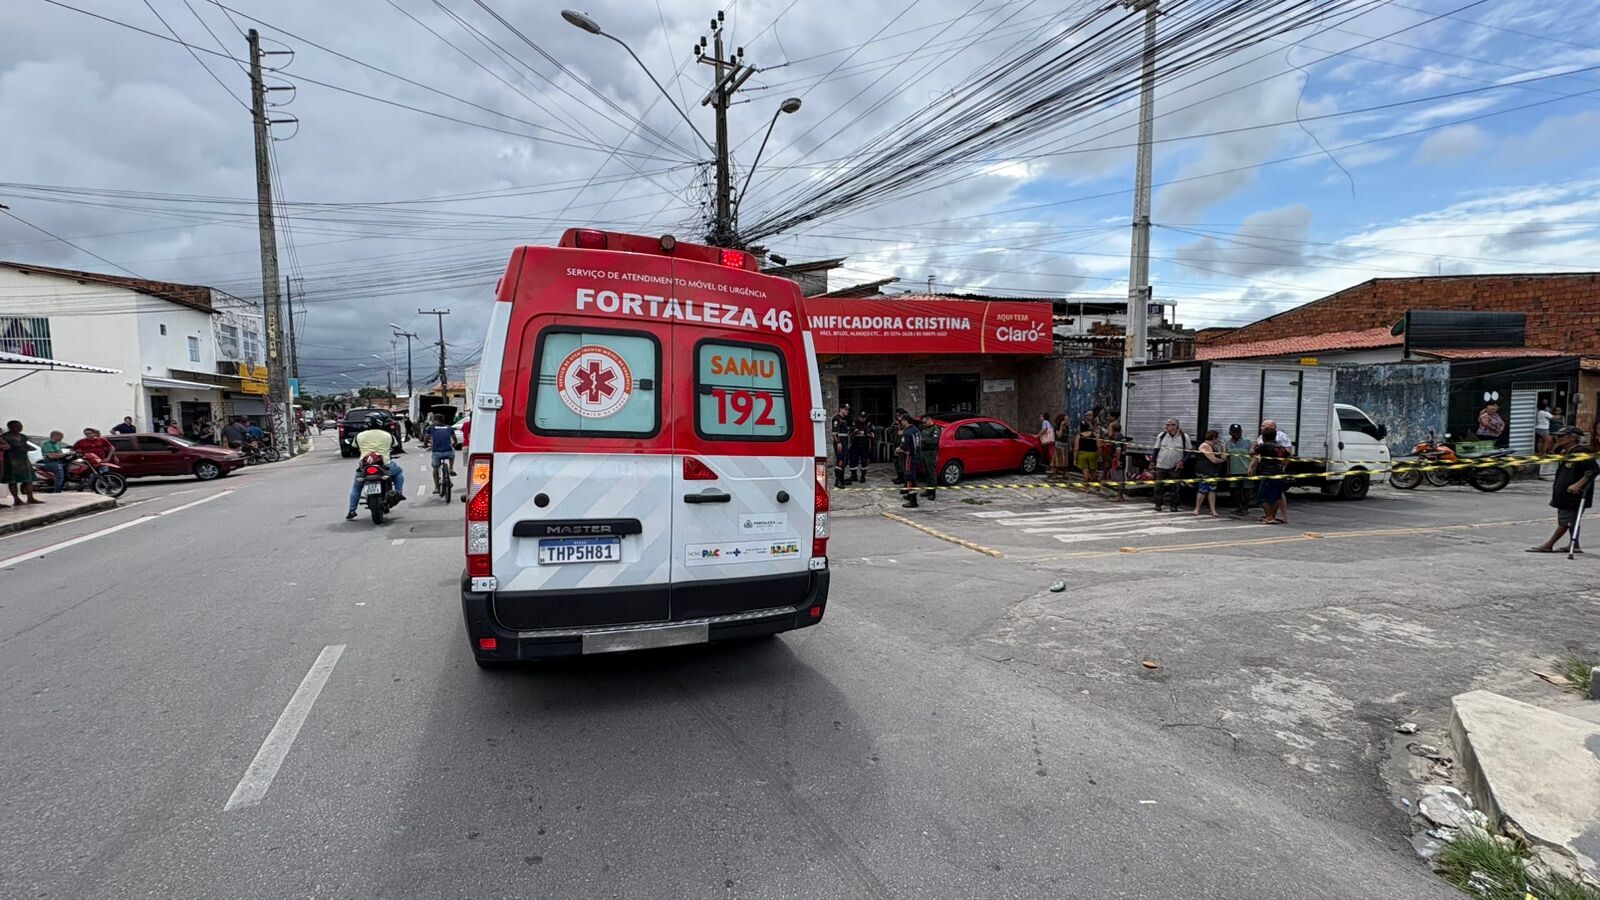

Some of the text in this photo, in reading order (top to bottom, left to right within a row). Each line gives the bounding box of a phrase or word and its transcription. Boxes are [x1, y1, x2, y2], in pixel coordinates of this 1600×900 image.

[566, 267, 767, 299] SERVIÇO DE ATENDIMENTO MÓVEL DE URGÊNCIA
[576, 288, 794, 334] FORTALEZA 46
[996, 313, 1029, 323] AQUI TEM
[905, 317, 971, 330] CRISTINA
[996, 326, 1039, 342] Claro
[711, 355, 775, 378] SAMU
[711, 389, 777, 426] 192
[547, 525, 612, 534] MASTER
[547, 545, 613, 561] THP5H81
[702, 548, 720, 558] PAC
